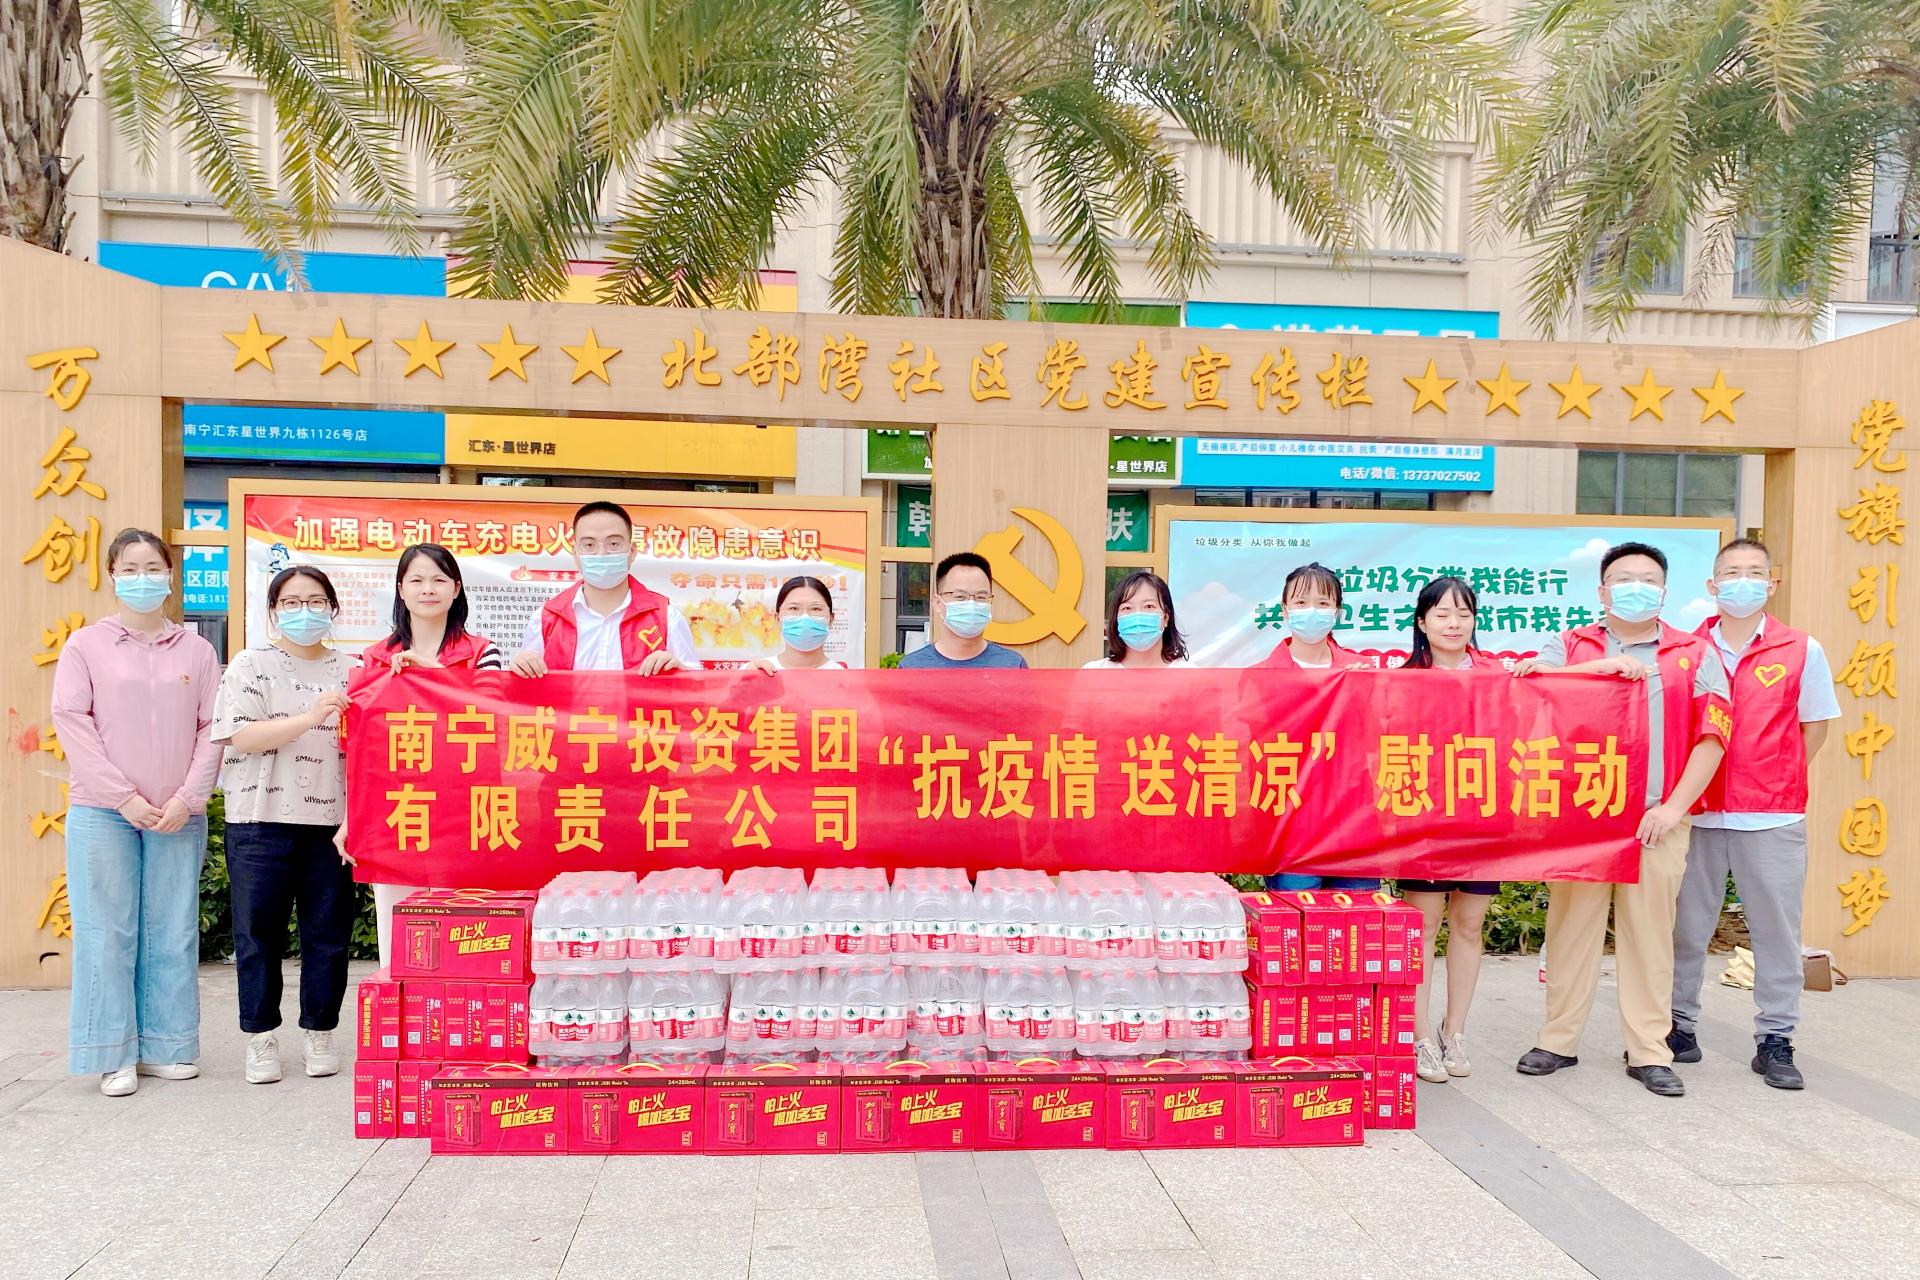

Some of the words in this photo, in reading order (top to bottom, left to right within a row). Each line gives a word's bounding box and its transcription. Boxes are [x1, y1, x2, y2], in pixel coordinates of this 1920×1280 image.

[662, 325, 1374, 415] 北部湾社区党建宣传栏
[1402, 469, 1481, 482] 13737027502
[1836, 398, 1908, 937] 党旗引领中国梦
[385, 704, 859, 775] 南宁威宁投资集团
[878, 732, 1100, 820] “抗疫情
[1120, 731, 1336, 818] 送清凉”
[1376, 733, 1628, 819] 慰问活动
[385, 784, 859, 853] 有限责任公司
